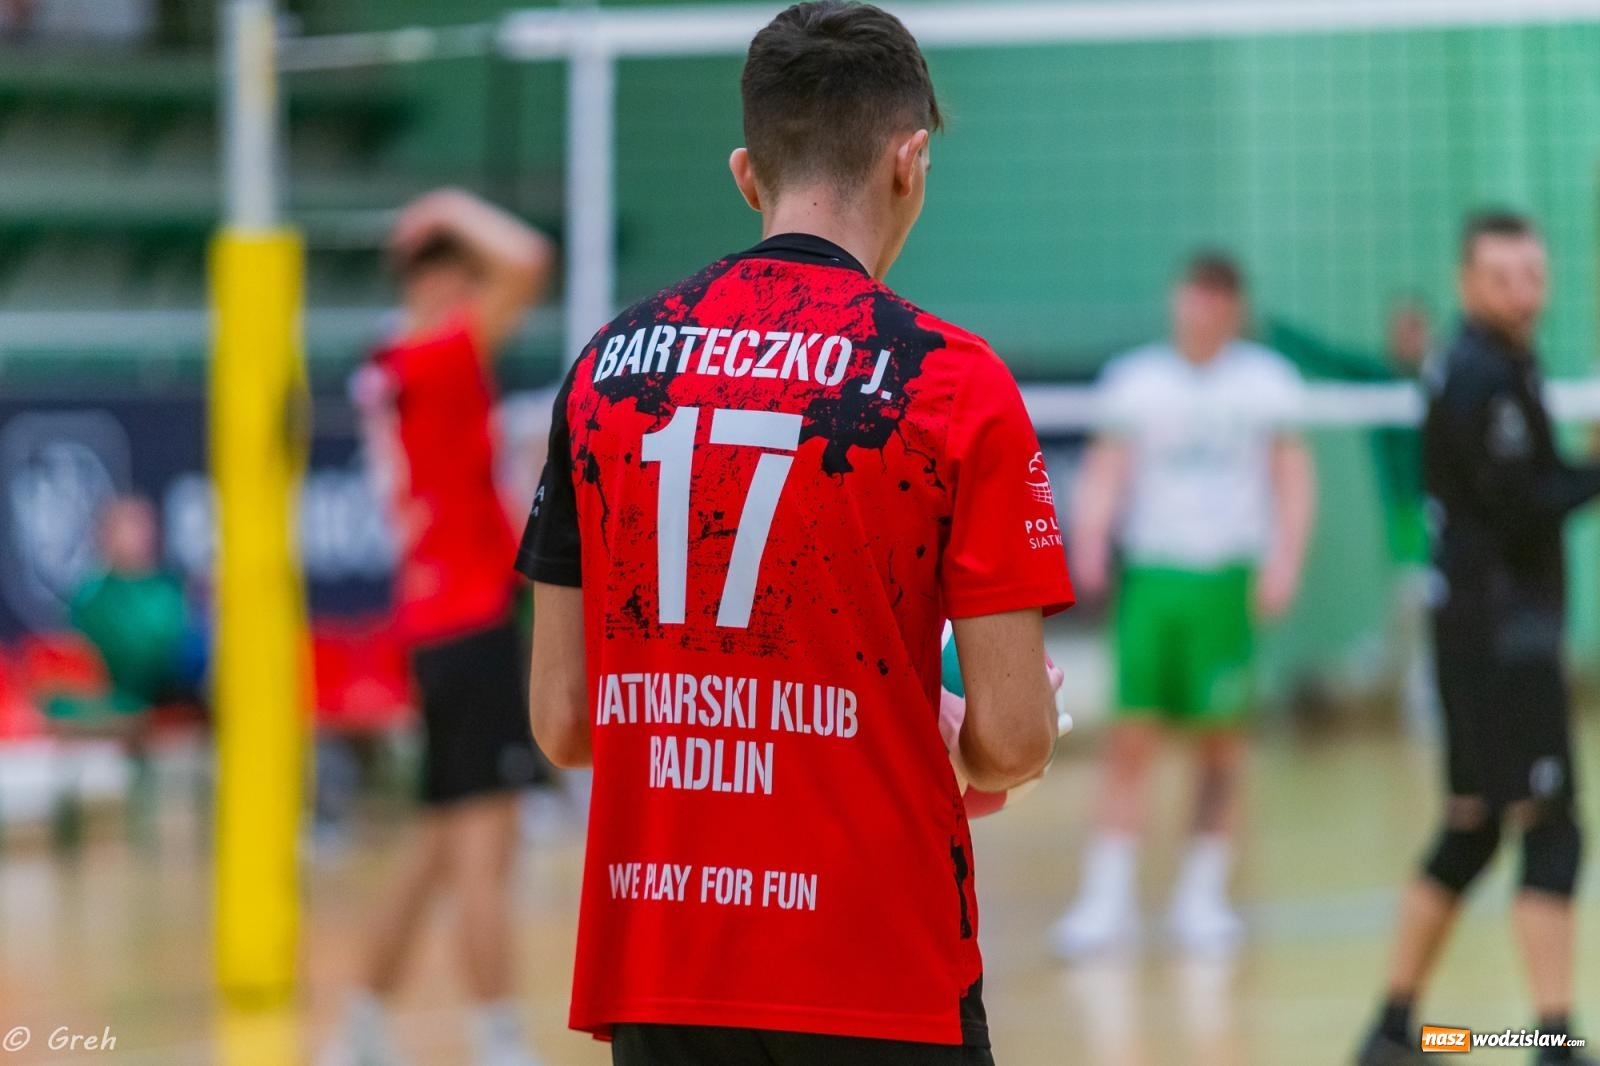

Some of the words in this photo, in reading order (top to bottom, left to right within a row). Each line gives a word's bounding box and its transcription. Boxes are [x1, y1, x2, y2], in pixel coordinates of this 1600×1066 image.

[593, 325, 853, 384] BARTECZKO
[860, 349, 893, 401] J.
[641, 405, 804, 629] 17
[1024, 516, 1060, 534] POL
[1029, 534, 1064, 550] SIATK
[770, 680, 858, 738] KLUB
[649, 735, 774, 795] RADLIN
[608, 862, 642, 900] WE
[643, 863, 693, 902] PLAY
[700, 866, 753, 906] FOR
[762, 870, 818, 911] FUN
